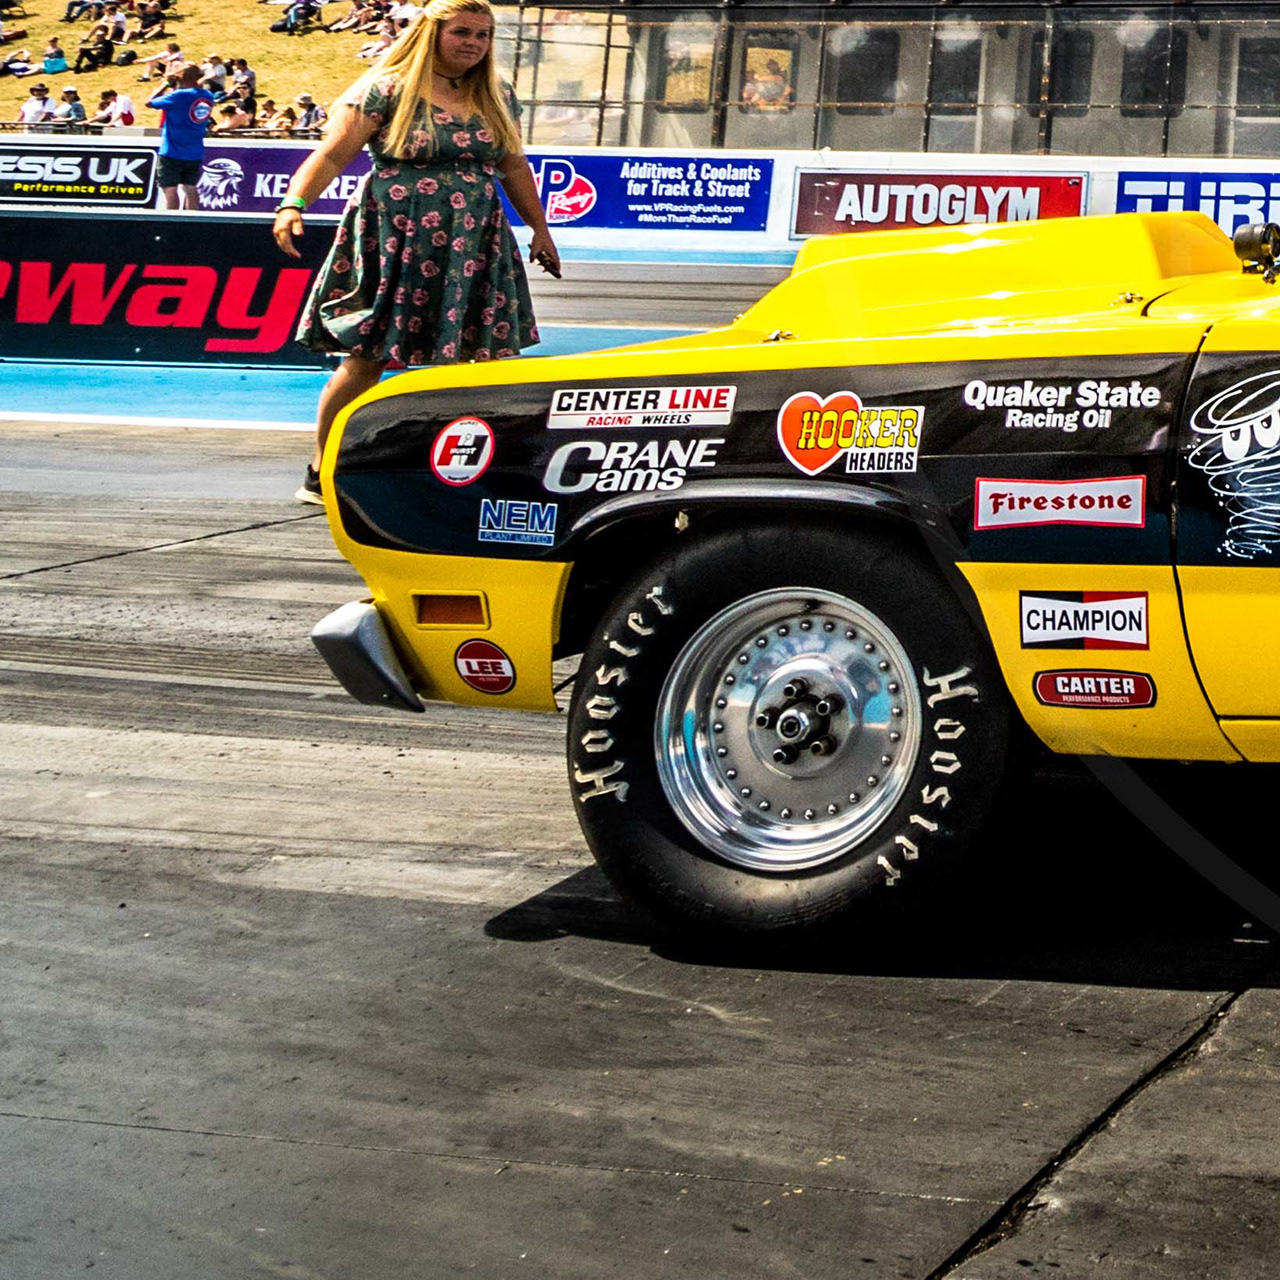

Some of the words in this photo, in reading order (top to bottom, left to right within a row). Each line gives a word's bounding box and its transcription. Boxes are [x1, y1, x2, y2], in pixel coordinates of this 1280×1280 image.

[88, 157, 148, 184] UK
[620, 161, 684, 179] Additives
[686, 163, 697, 180] &
[700, 163, 761, 181] Coolants
[13, 183, 96, 194] Performance
[100, 184, 144, 195] Driven
[626, 179, 648, 196] for
[651, 180, 690, 197] Track
[693, 181, 703, 197] &
[707, 180, 751, 198] Street
[835, 184, 1041, 226] AUTOGLYM
[0, 261, 313, 353] way
[555, 390, 660, 412] CENTER
[668, 388, 730, 410] LINE
[963, 380, 1072, 409] Quaker
[1075, 380, 1161, 408] State
[586, 415, 632, 427] RACING
[641, 414, 692, 426] WHEELS
[797, 408, 919, 451] HOOKER
[1005, 408, 1079, 432] Racing
[1083, 408, 1112, 428] Oil
[848, 451, 915, 471] HEADERS
[479, 498, 558, 533] NEM
[988, 491, 1133, 516] Firestone
[484, 531, 513, 540] PLANT
[515, 533, 548, 543] LIMITED
[1026, 609, 1142, 632] CHAMPION
[465, 660, 505, 675] LEE
[574, 586, 674, 804] Hoosier
[1055, 676, 1136, 695] CARTER
[1102, 695, 1130, 704] PRODUCTS
[878, 665, 980, 886] Hoosier
